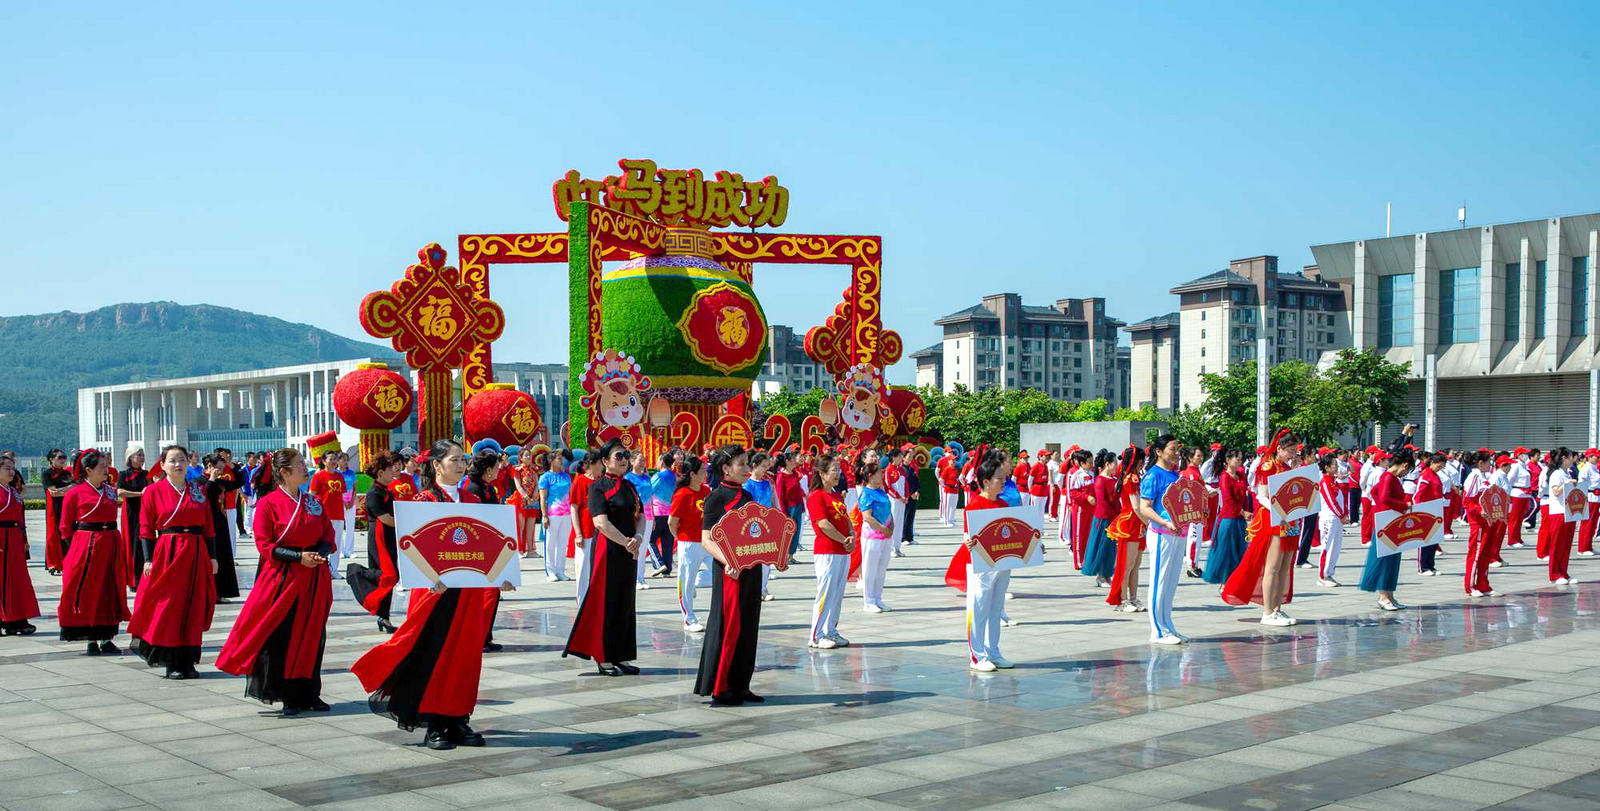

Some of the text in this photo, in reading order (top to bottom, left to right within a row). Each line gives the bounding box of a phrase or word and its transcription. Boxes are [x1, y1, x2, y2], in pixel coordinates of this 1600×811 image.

[619, 159, 790, 228] 马到成功
[418, 295, 457, 340] 福
[720, 308, 748, 345] 福
[374, 384, 403, 413] 福
[511, 406, 536, 435] 福
